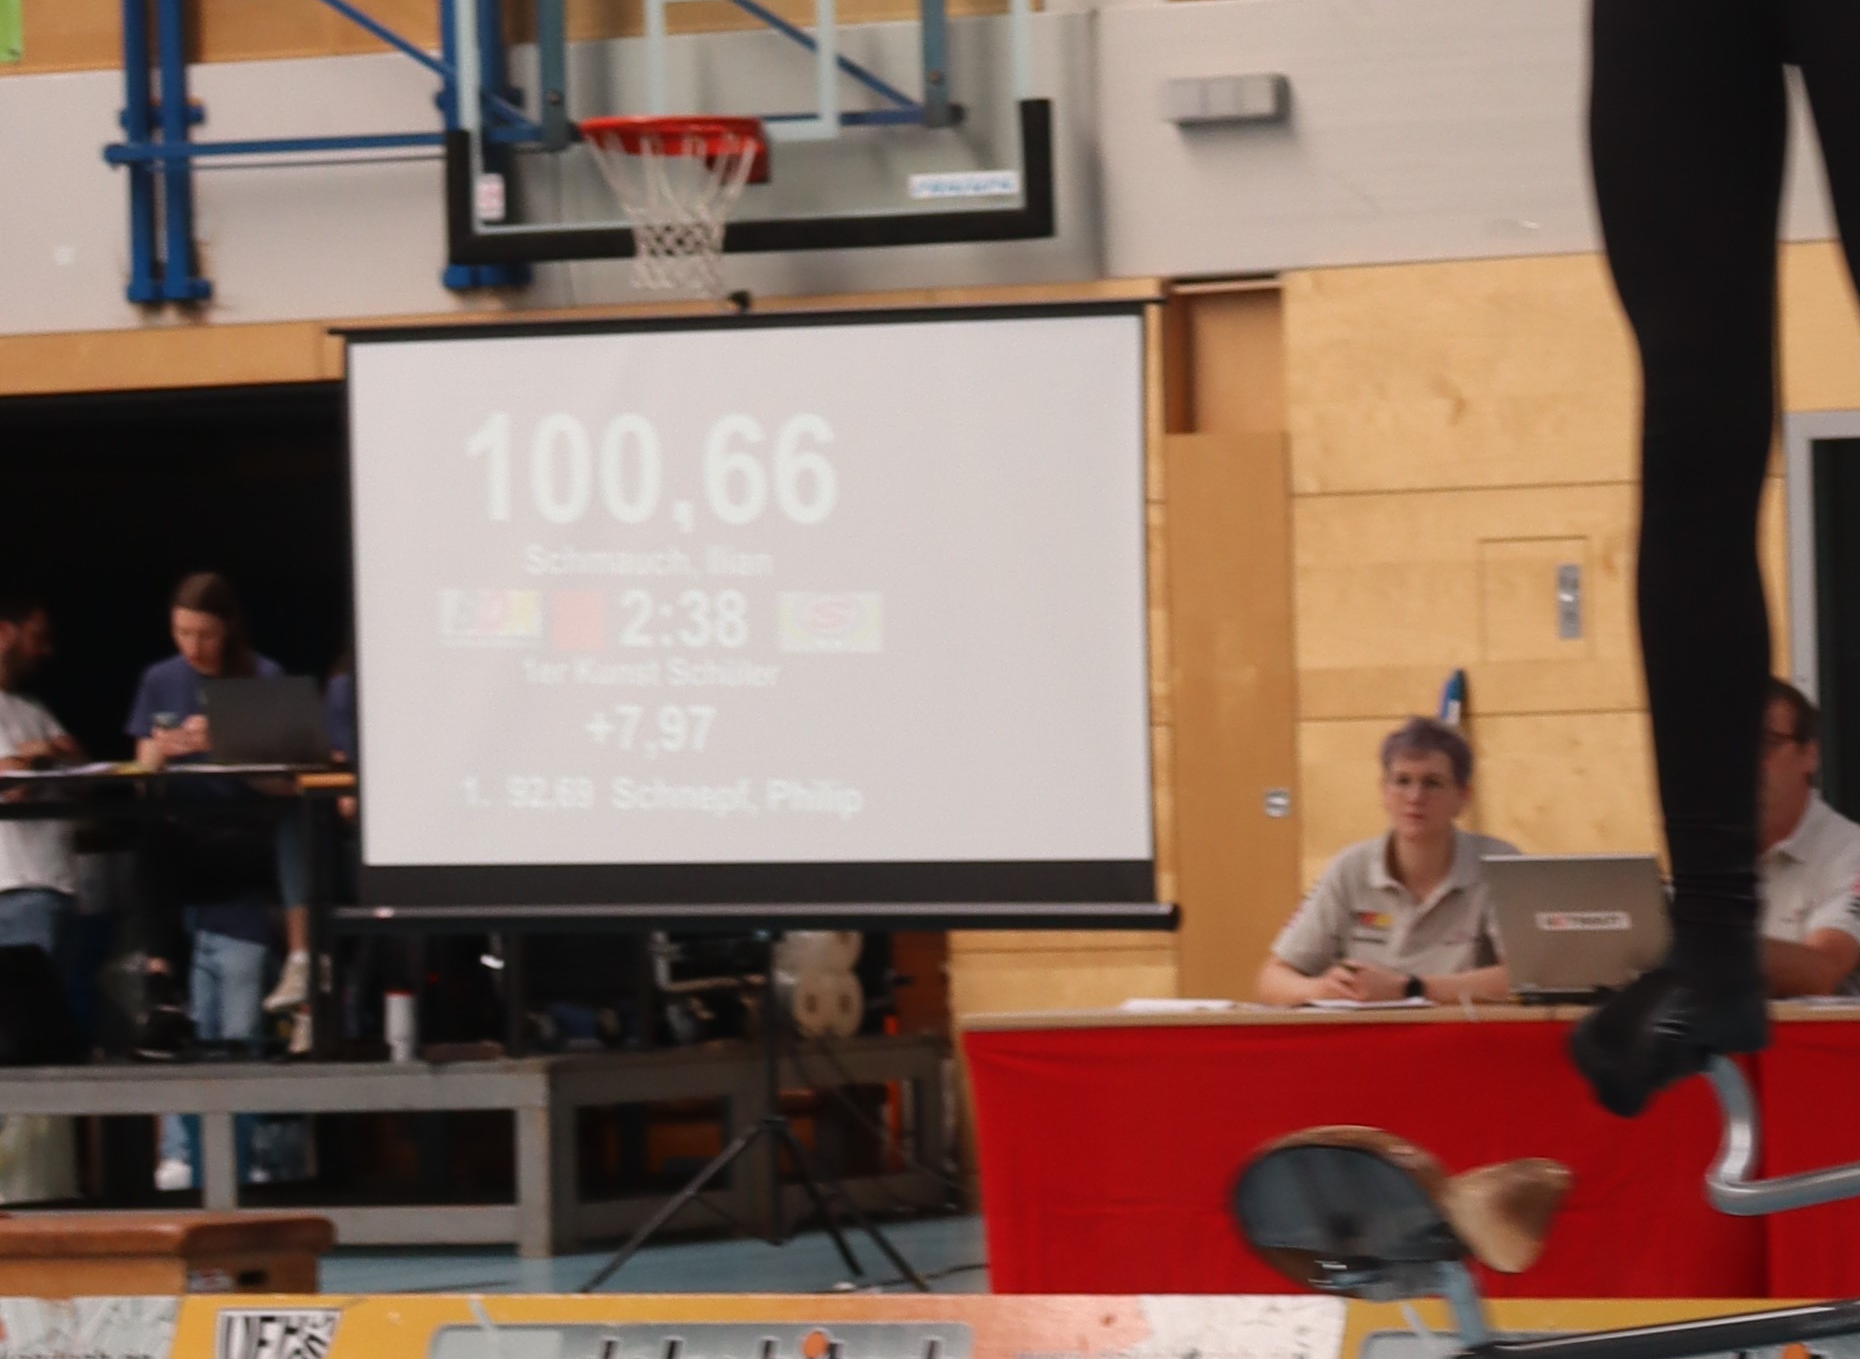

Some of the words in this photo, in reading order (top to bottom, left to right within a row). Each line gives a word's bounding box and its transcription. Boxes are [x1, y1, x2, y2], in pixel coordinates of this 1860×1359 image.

[465, 411, 839, 533] 100,66
[618, 588, 749, 649] 2:38
[583, 703, 717, 763] +7,97
